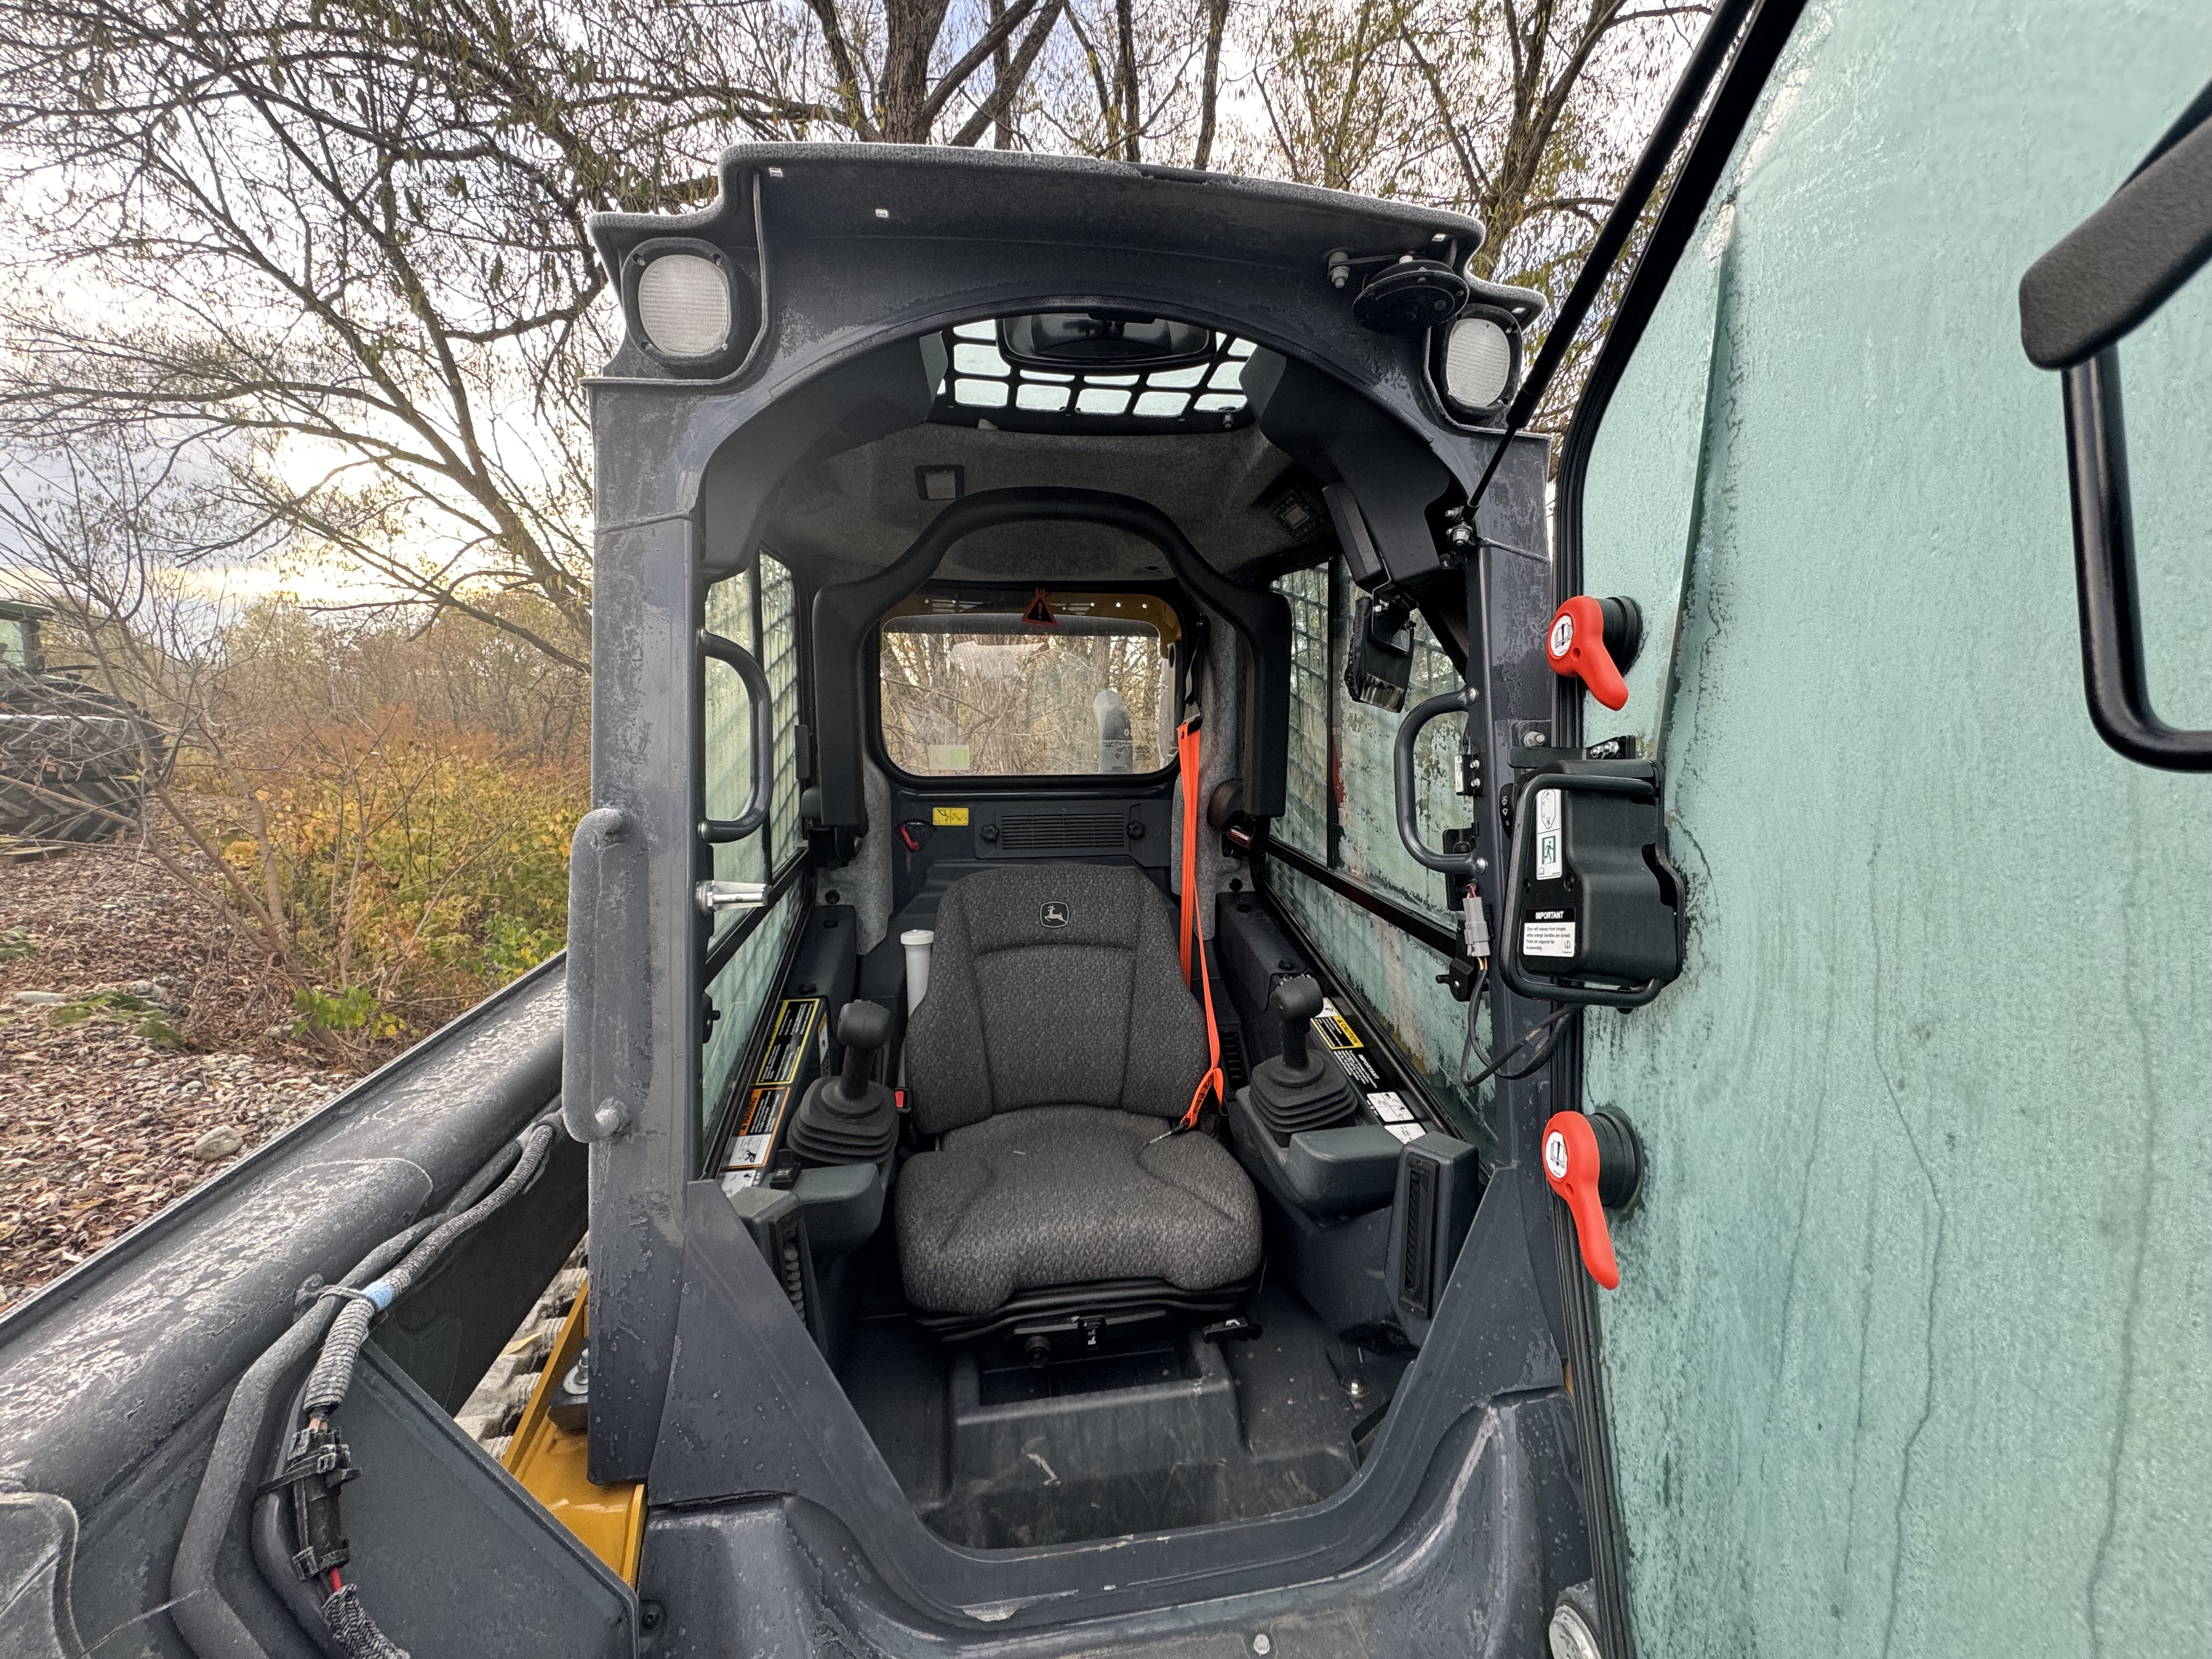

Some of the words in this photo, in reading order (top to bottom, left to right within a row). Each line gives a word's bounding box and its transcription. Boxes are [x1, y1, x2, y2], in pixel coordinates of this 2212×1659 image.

[1535, 911, 1564, 919] IMPORTANT
[1341, 1023, 1359, 1043] CAUTION
[1358, 1054, 1380, 1080] IMPORTANT
[744, 1097, 757, 1124] WARNING
